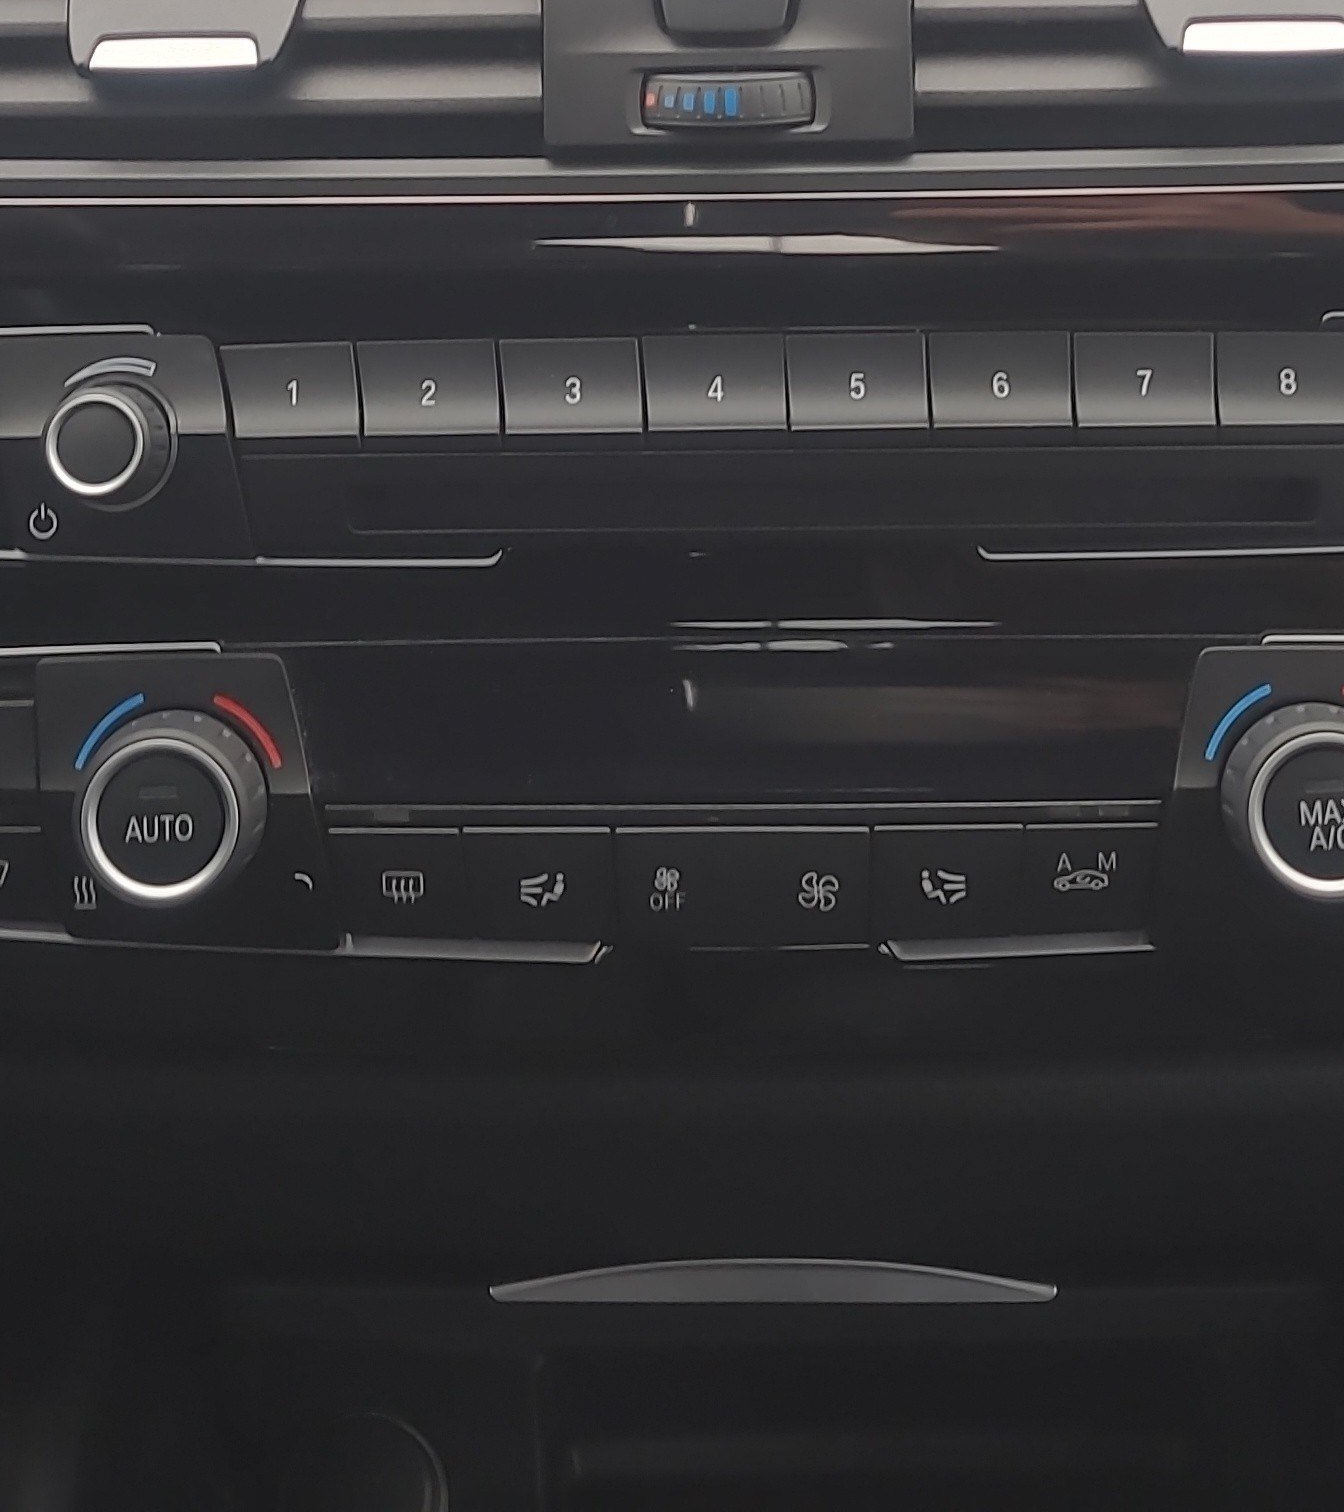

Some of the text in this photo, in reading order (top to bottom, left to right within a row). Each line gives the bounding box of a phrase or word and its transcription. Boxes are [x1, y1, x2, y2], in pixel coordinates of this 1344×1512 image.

[286, 379, 299, 407] 1
[420, 379, 437, 407] 2
[564, 376, 582, 405] 3
[707, 375, 725, 403] 4
[848, 372, 866, 401] 5
[991, 370, 1011, 399] 6
[1135, 368, 1154, 398] 7
[1278, 367, 1298, 396] 8
[124, 812, 195, 844] AUTO
[1057, 850, 1117, 873] A M
[649, 891, 687, 913] OFF
